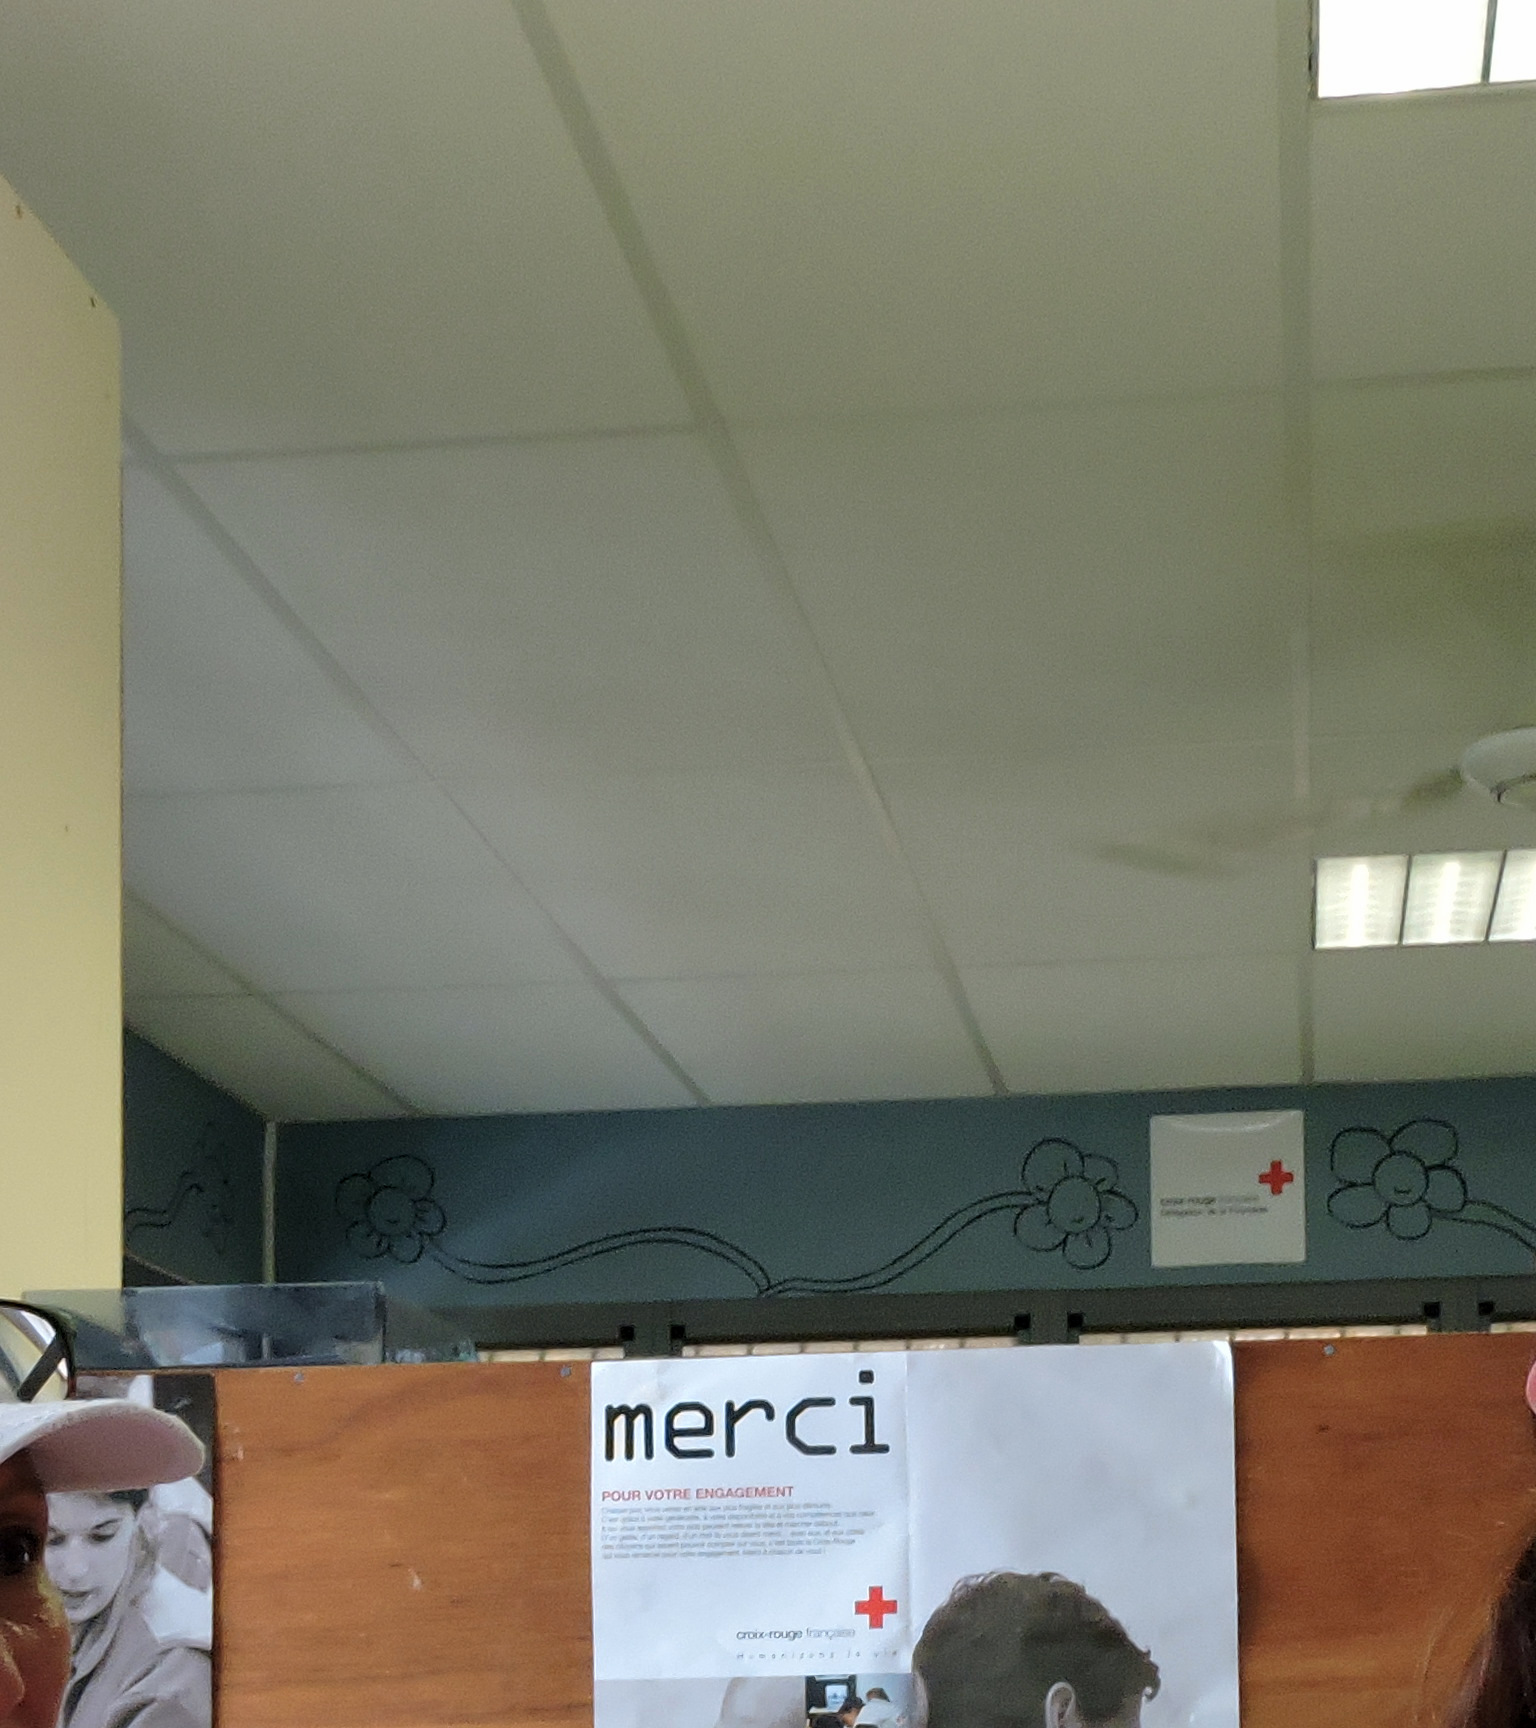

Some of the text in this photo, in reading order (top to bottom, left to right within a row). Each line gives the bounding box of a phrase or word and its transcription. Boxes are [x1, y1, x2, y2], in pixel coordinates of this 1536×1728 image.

[604, 1370, 891, 1461] merci
[601, 1486, 794, 1502] POUR VOTRE ENGAGEMENT
